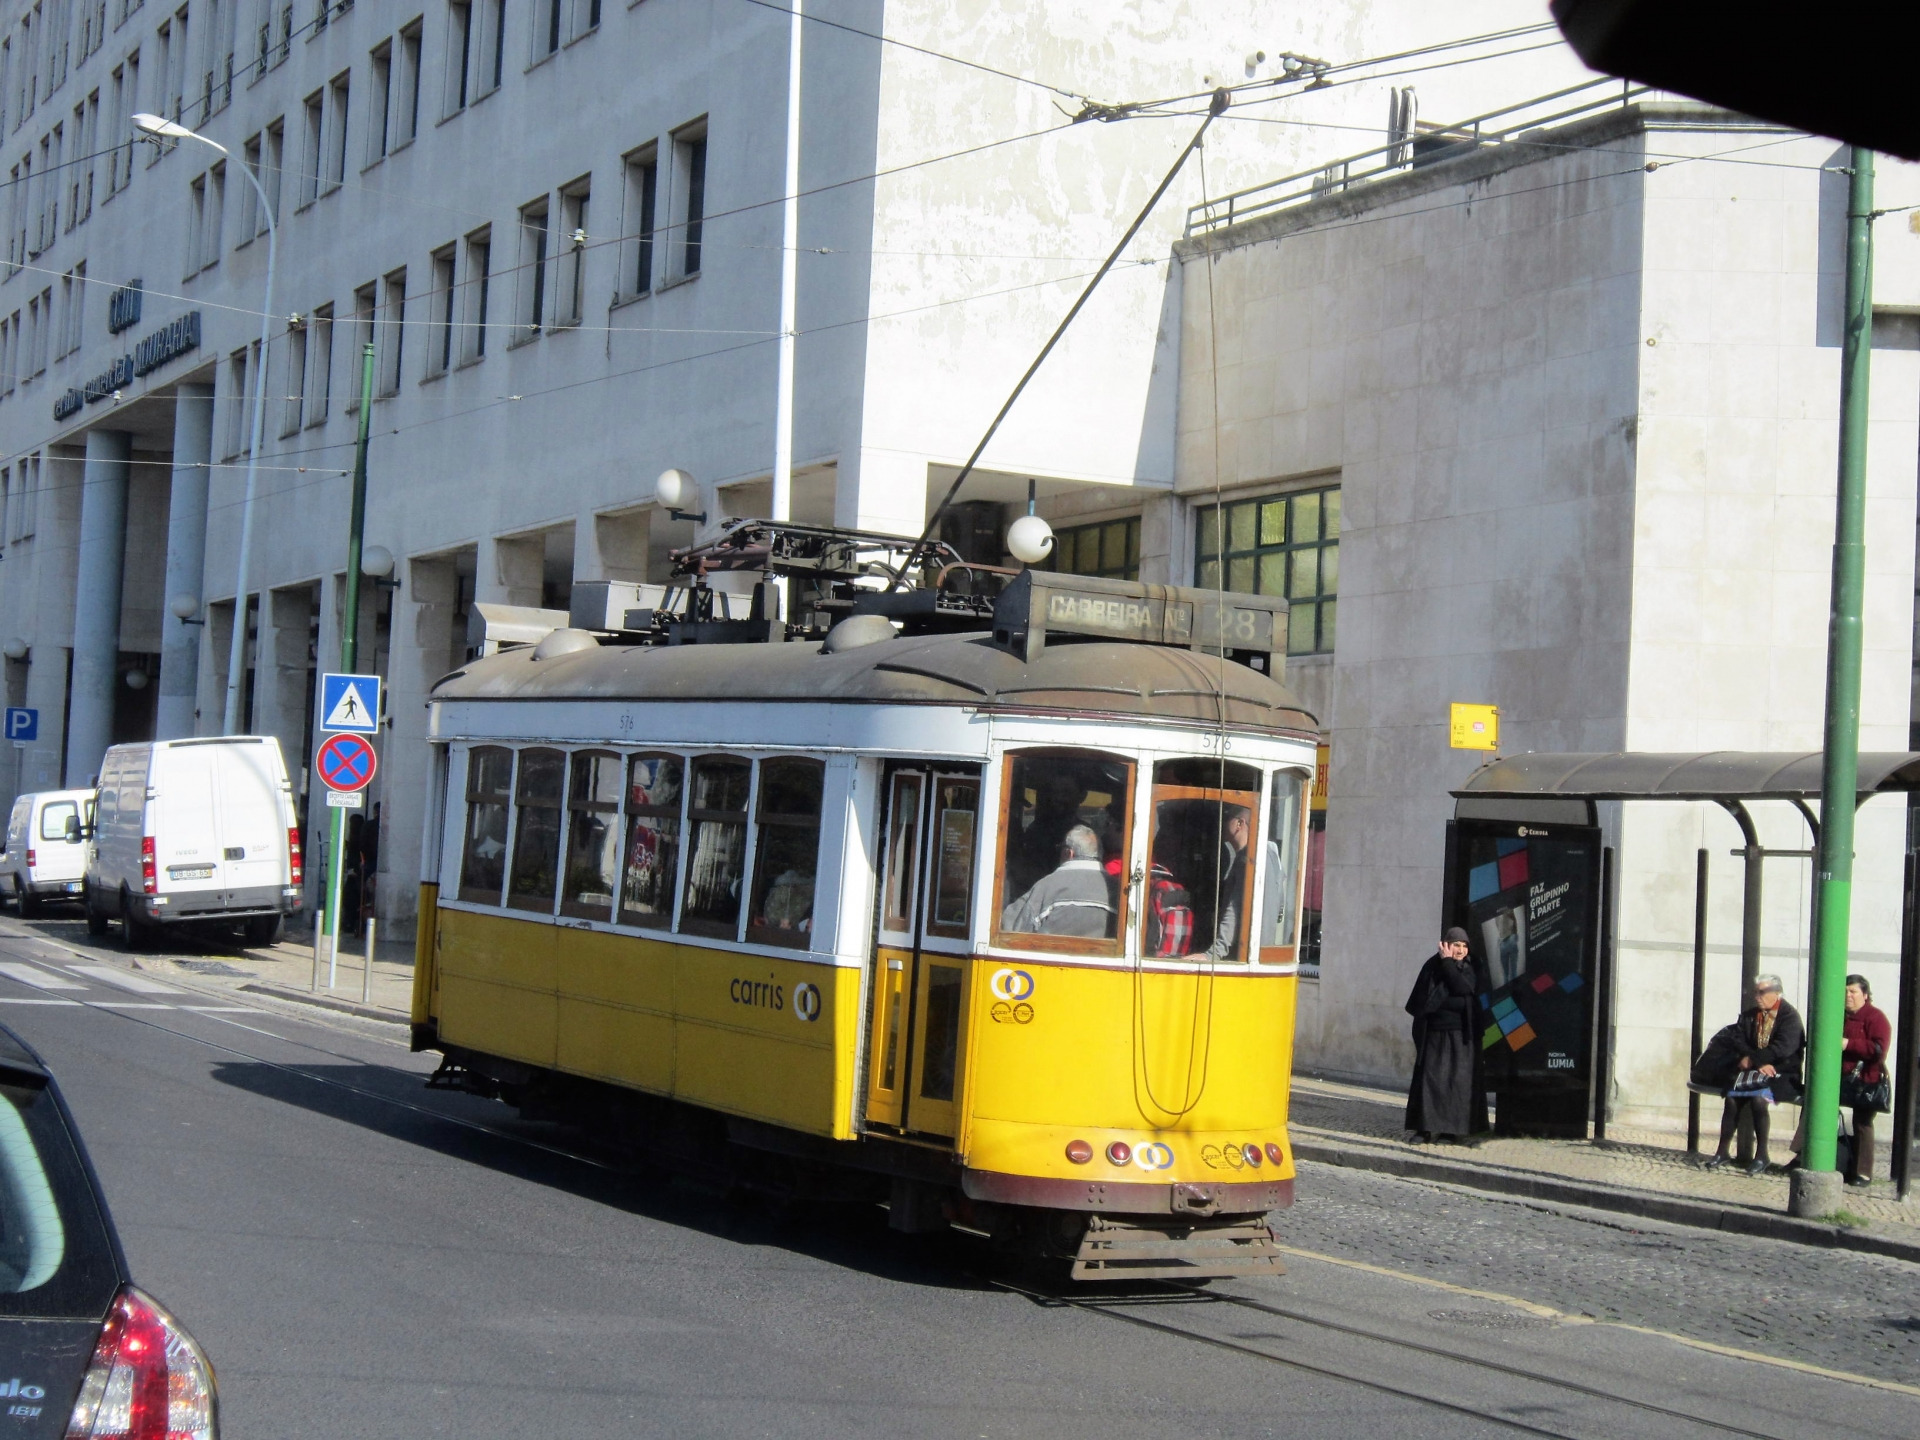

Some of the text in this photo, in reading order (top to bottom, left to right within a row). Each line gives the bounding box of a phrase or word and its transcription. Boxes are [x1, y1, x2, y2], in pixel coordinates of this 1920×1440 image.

[1050, 596, 1152, 628] CARREIRA
[1215, 608, 1256, 642] 28
[11, 710, 31, 737] P
[620, 715, 634, 730] 576
[1203, 732, 1231, 750] 576
[1530, 881, 1545, 897] FAZ
[1530, 882, 1570, 909] GRUPINHO
[1537, 897, 1561, 917] PARTE
[730, 973, 784, 1011] carris
[1548, 1058, 1575, 1068] LUMIA
